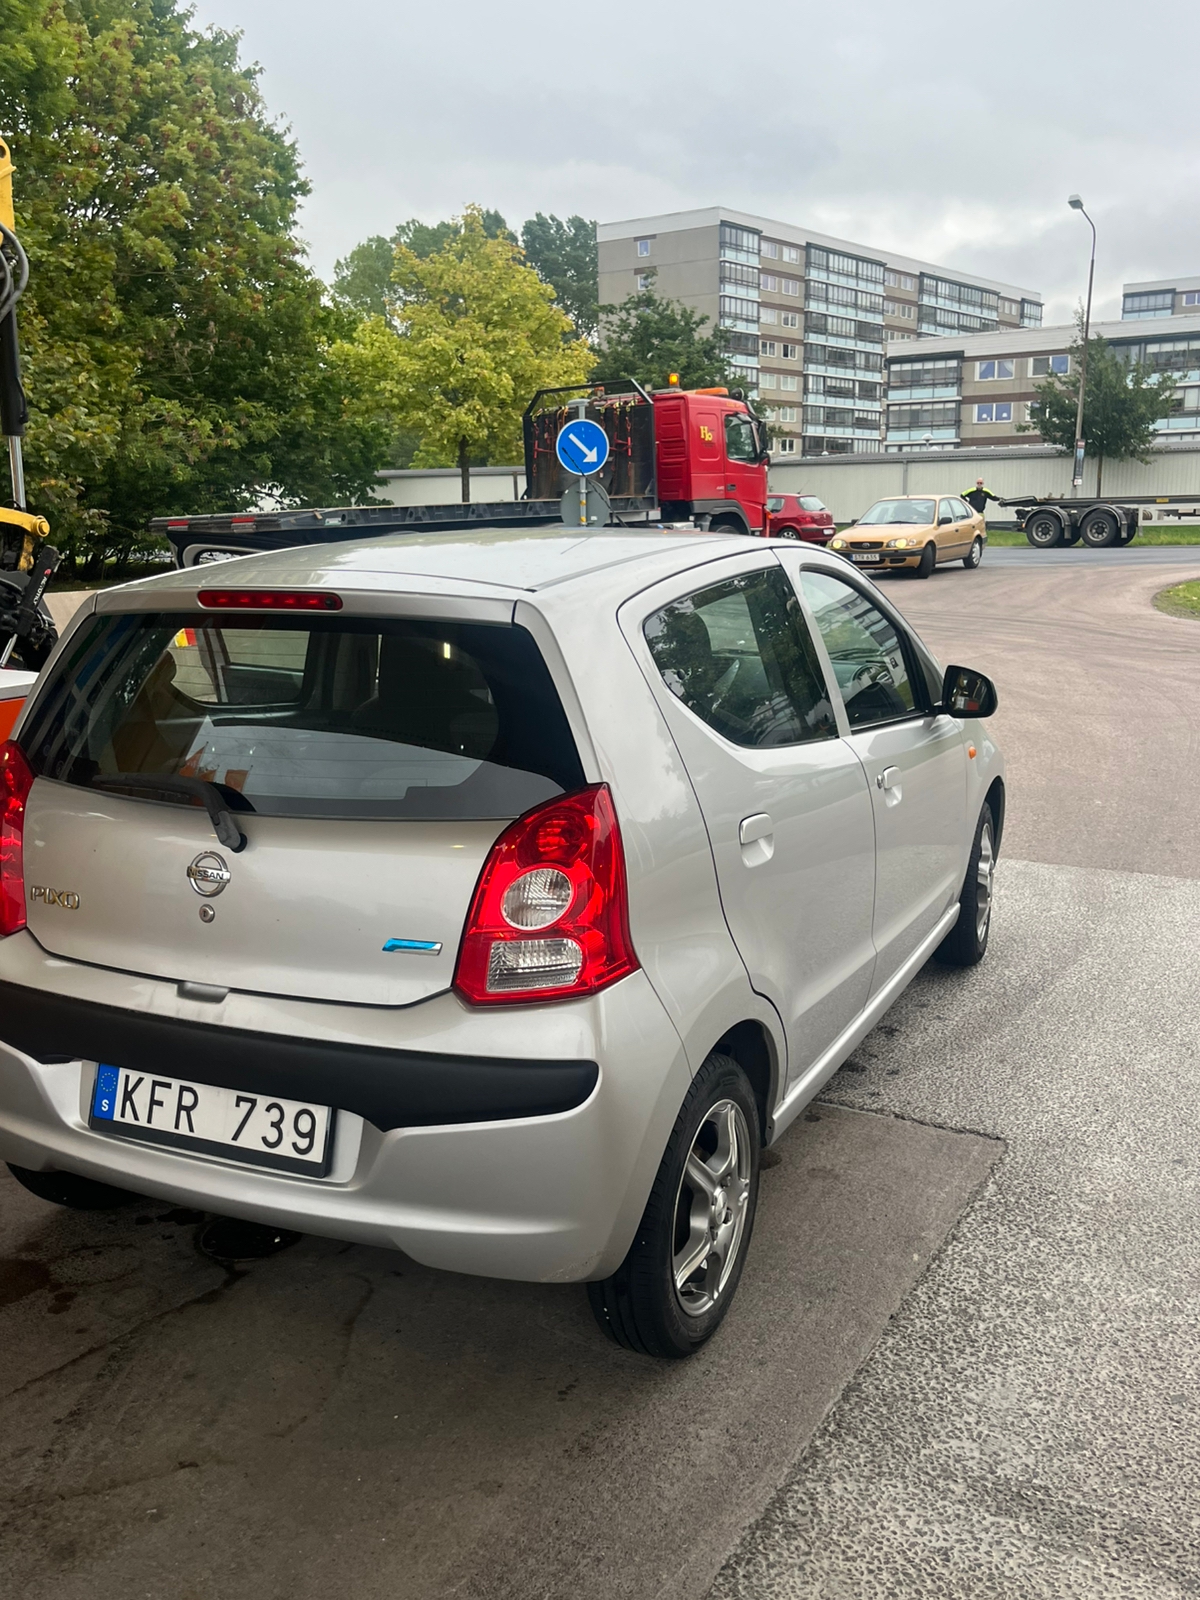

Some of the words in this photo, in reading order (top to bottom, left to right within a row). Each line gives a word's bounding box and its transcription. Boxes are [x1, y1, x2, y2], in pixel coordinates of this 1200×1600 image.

[190, 867, 224, 880] NISSAN
[30, 885, 80, 910] PIXO
[101, 1099, 109, 1112] S
[120, 1074, 199, 1133] KFR
[231, 1095, 317, 1156] 739
